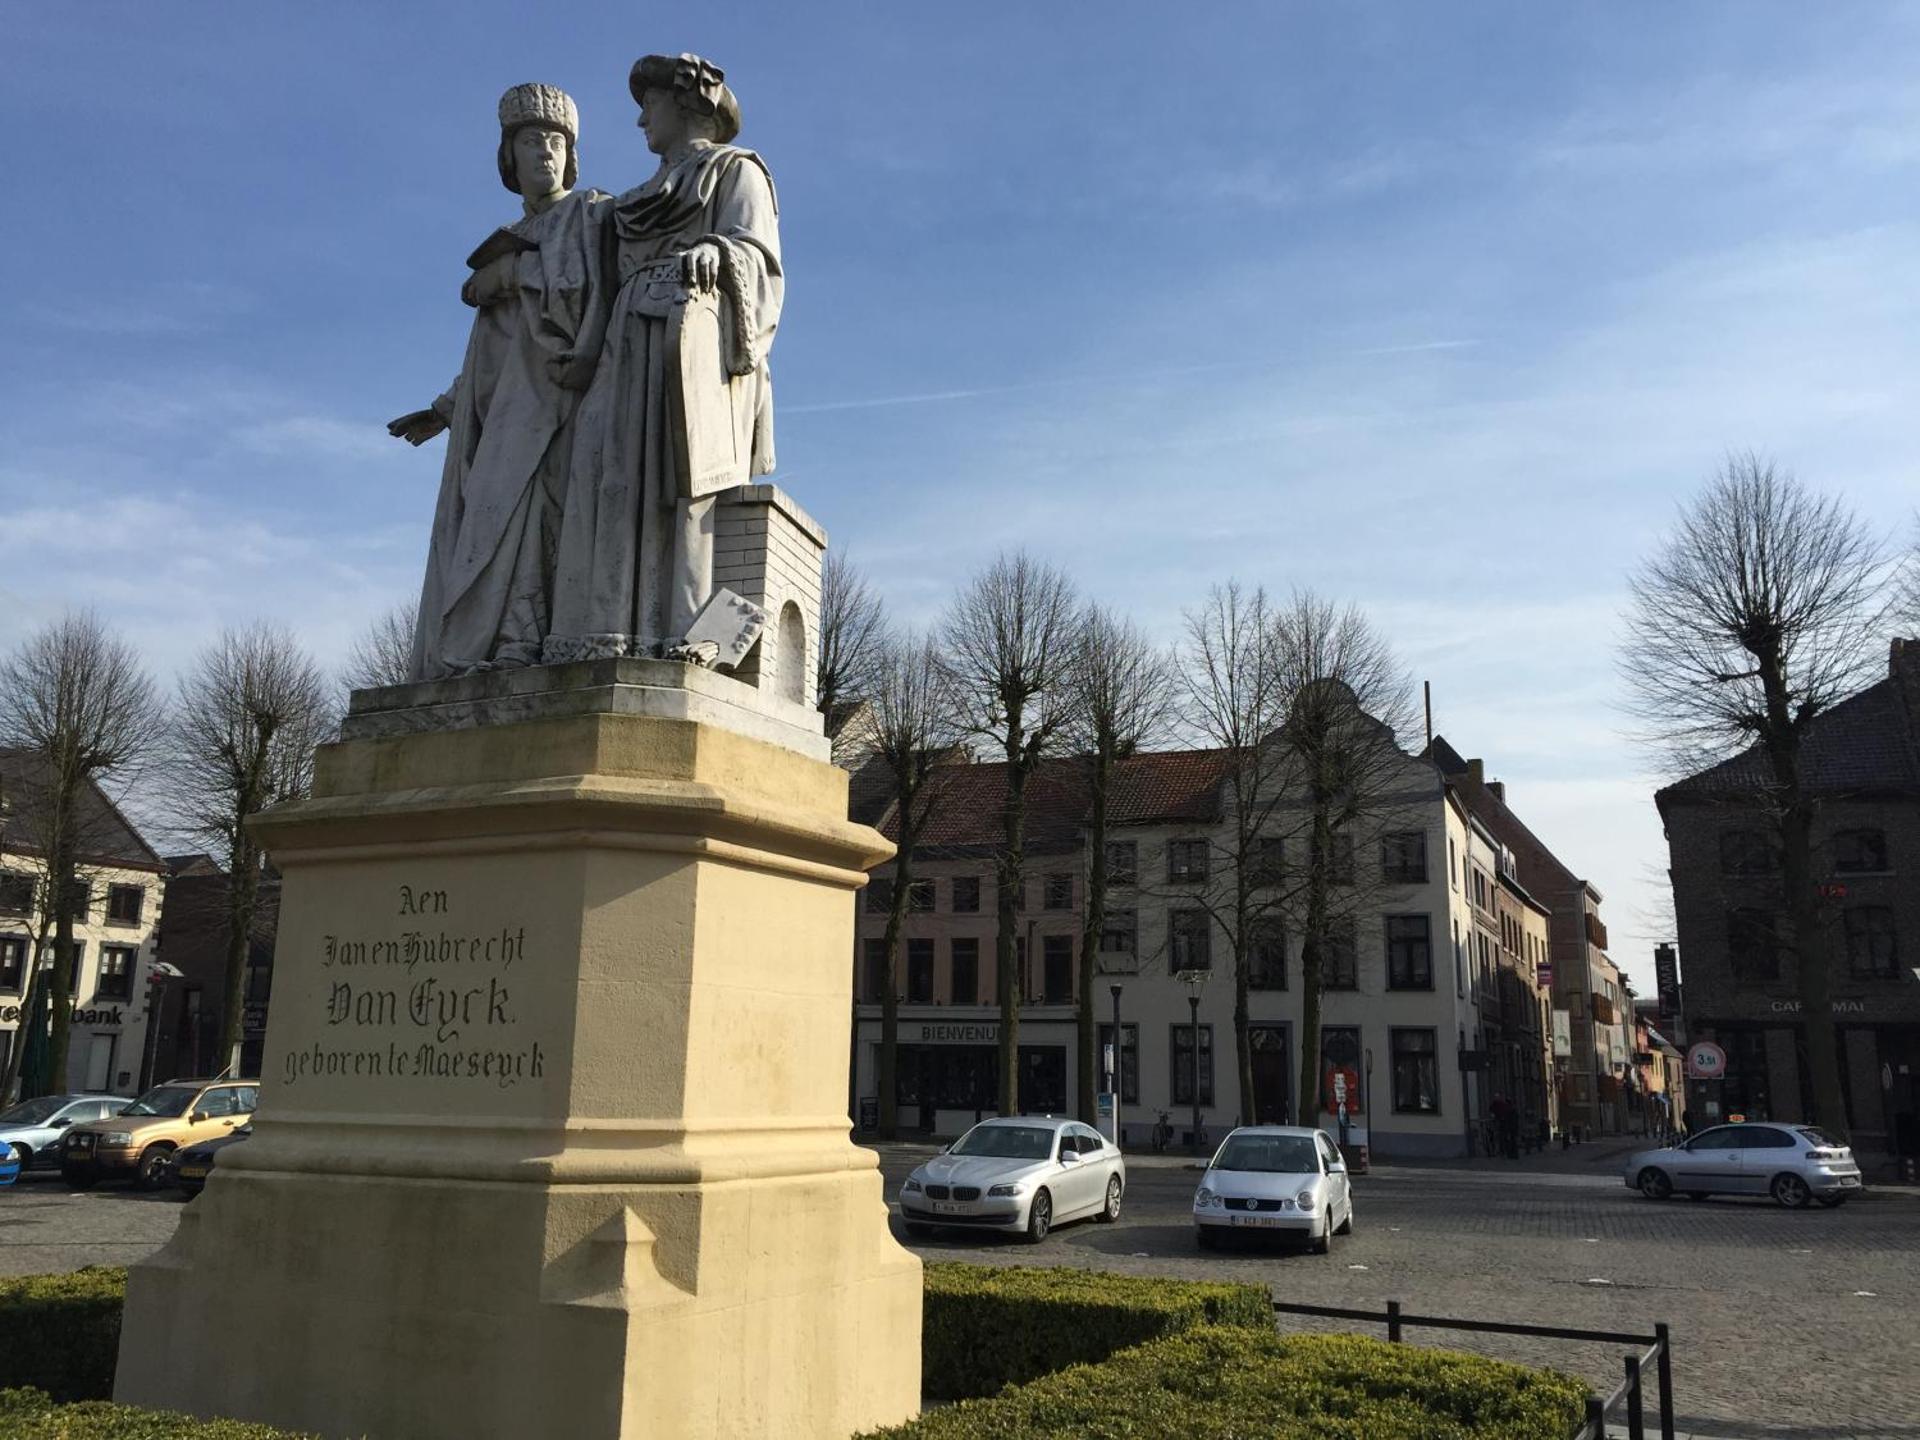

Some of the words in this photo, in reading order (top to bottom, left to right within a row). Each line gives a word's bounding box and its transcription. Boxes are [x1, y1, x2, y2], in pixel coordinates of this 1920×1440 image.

[399, 885, 448, 914] Aen
[328, 982, 396, 1025] Van
[1771, 1001, 1802, 1013] CAF
[1832, 1002, 1865, 1013] MAI
[922, 1026, 1001, 1040] BIENVENU
